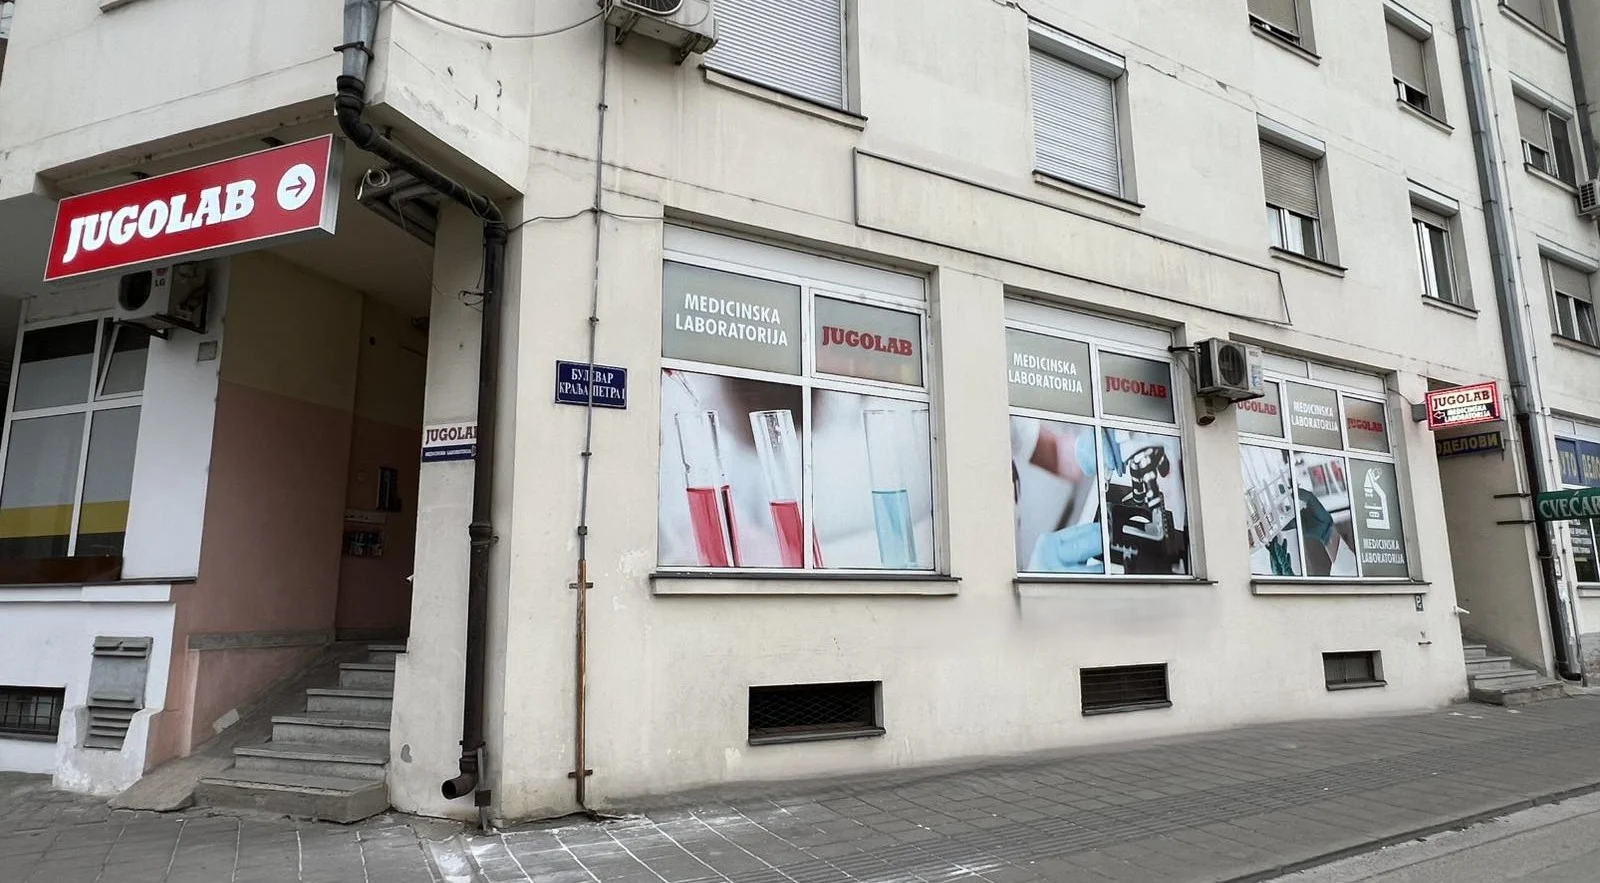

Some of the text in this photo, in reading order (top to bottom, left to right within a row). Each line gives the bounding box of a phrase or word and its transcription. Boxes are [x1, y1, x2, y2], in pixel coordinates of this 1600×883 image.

[62, 178, 257, 264] JUGOLAB
[154, 277, 166, 287] LG
[684, 293, 781, 325] MEDICINSKA
[675, 313, 788, 347] LABORATORIJA
[822, 325, 913, 356] JUGOLAB
[1013, 352, 1077, 376] MEDICINSKA
[571, 368, 614, 384] БУЛВАР
[1008, 368, 1083, 394] LABORATORIJA
[559, 381, 589, 396] КРАЉА
[592, 385, 621, 399] ПЕТРА
[1104, 375, 1168, 398] JUGOLAB
[1237, 400, 1277, 416] UGOLAB
[1433, 390, 1490, 410] JUGOLAB
[1293, 401, 1334, 418] MEDICINSKA
[1290, 415, 1339, 433] LABORATORIJA
[1347, 417, 1384, 433] JUGOLAB
[1363, 538, 1401, 550] MEDICINSKA
[1361, 552, 1406, 564] LABORATORIJA
